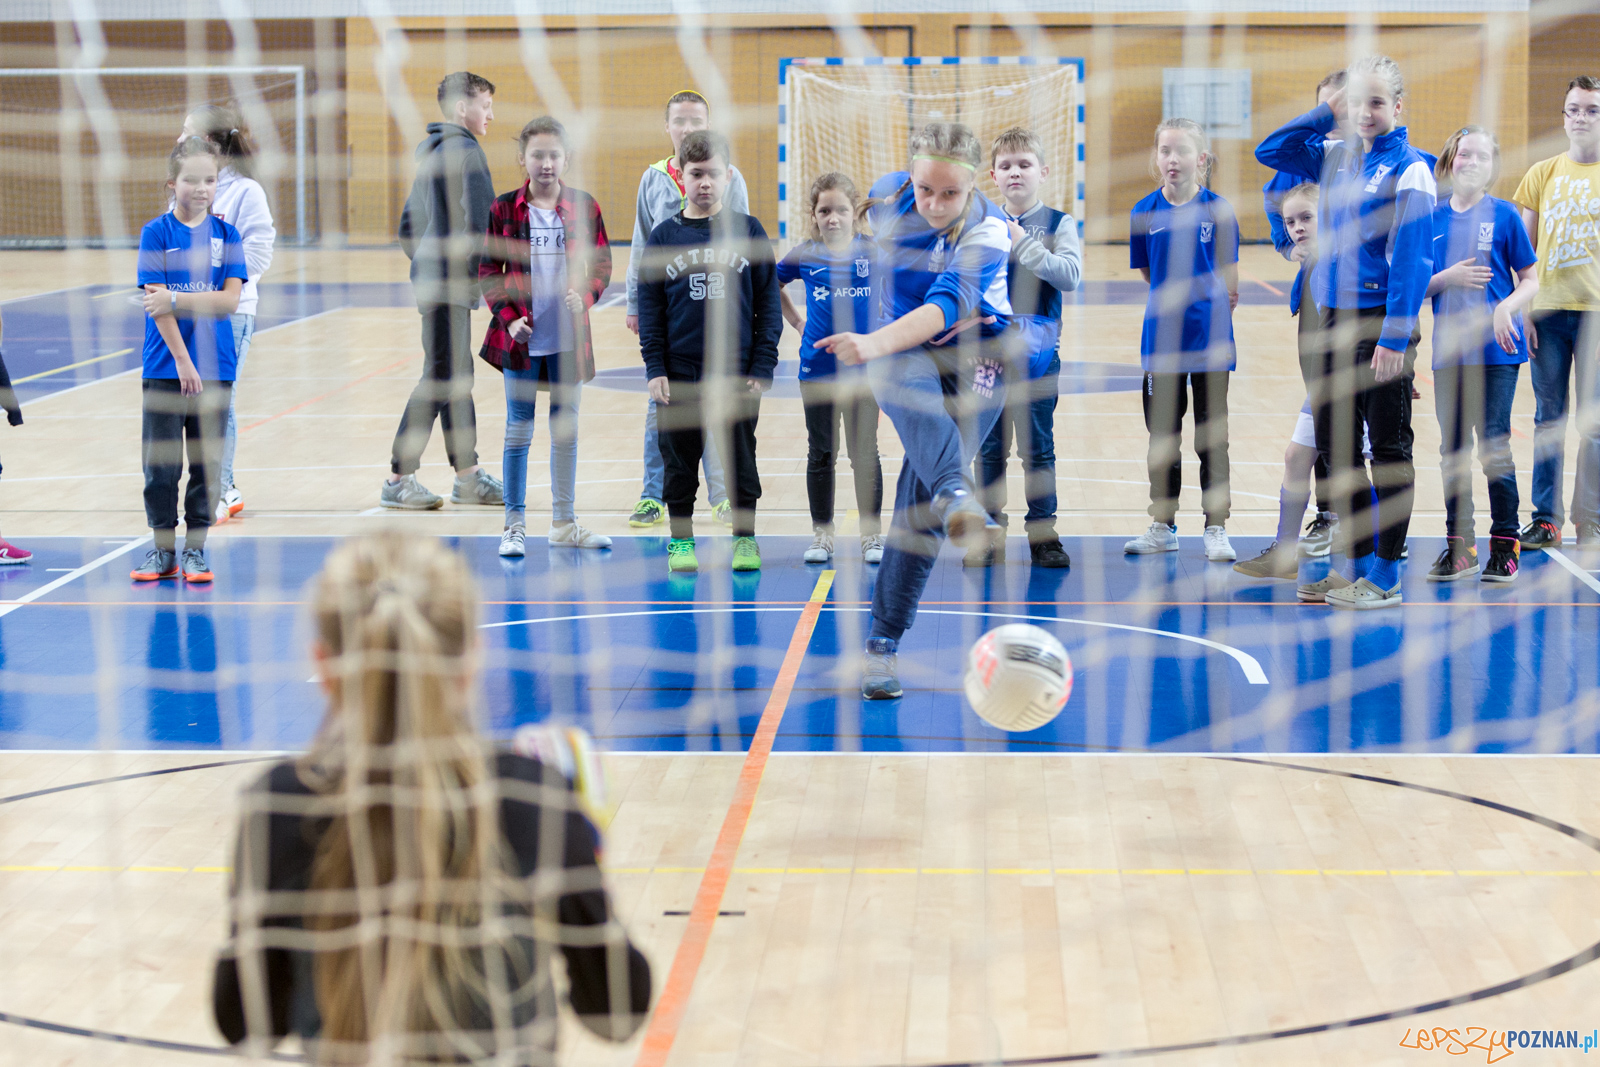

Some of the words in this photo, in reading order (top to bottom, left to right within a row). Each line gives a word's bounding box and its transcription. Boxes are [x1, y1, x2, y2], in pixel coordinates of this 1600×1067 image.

[1552, 175, 1591, 200] I'm
[530, 236, 549, 247] EEP
[665, 248, 750, 280] DETROIT
[1546, 240, 1588, 272] you
[688, 272, 726, 301] 52
[973, 365, 996, 389] 23
